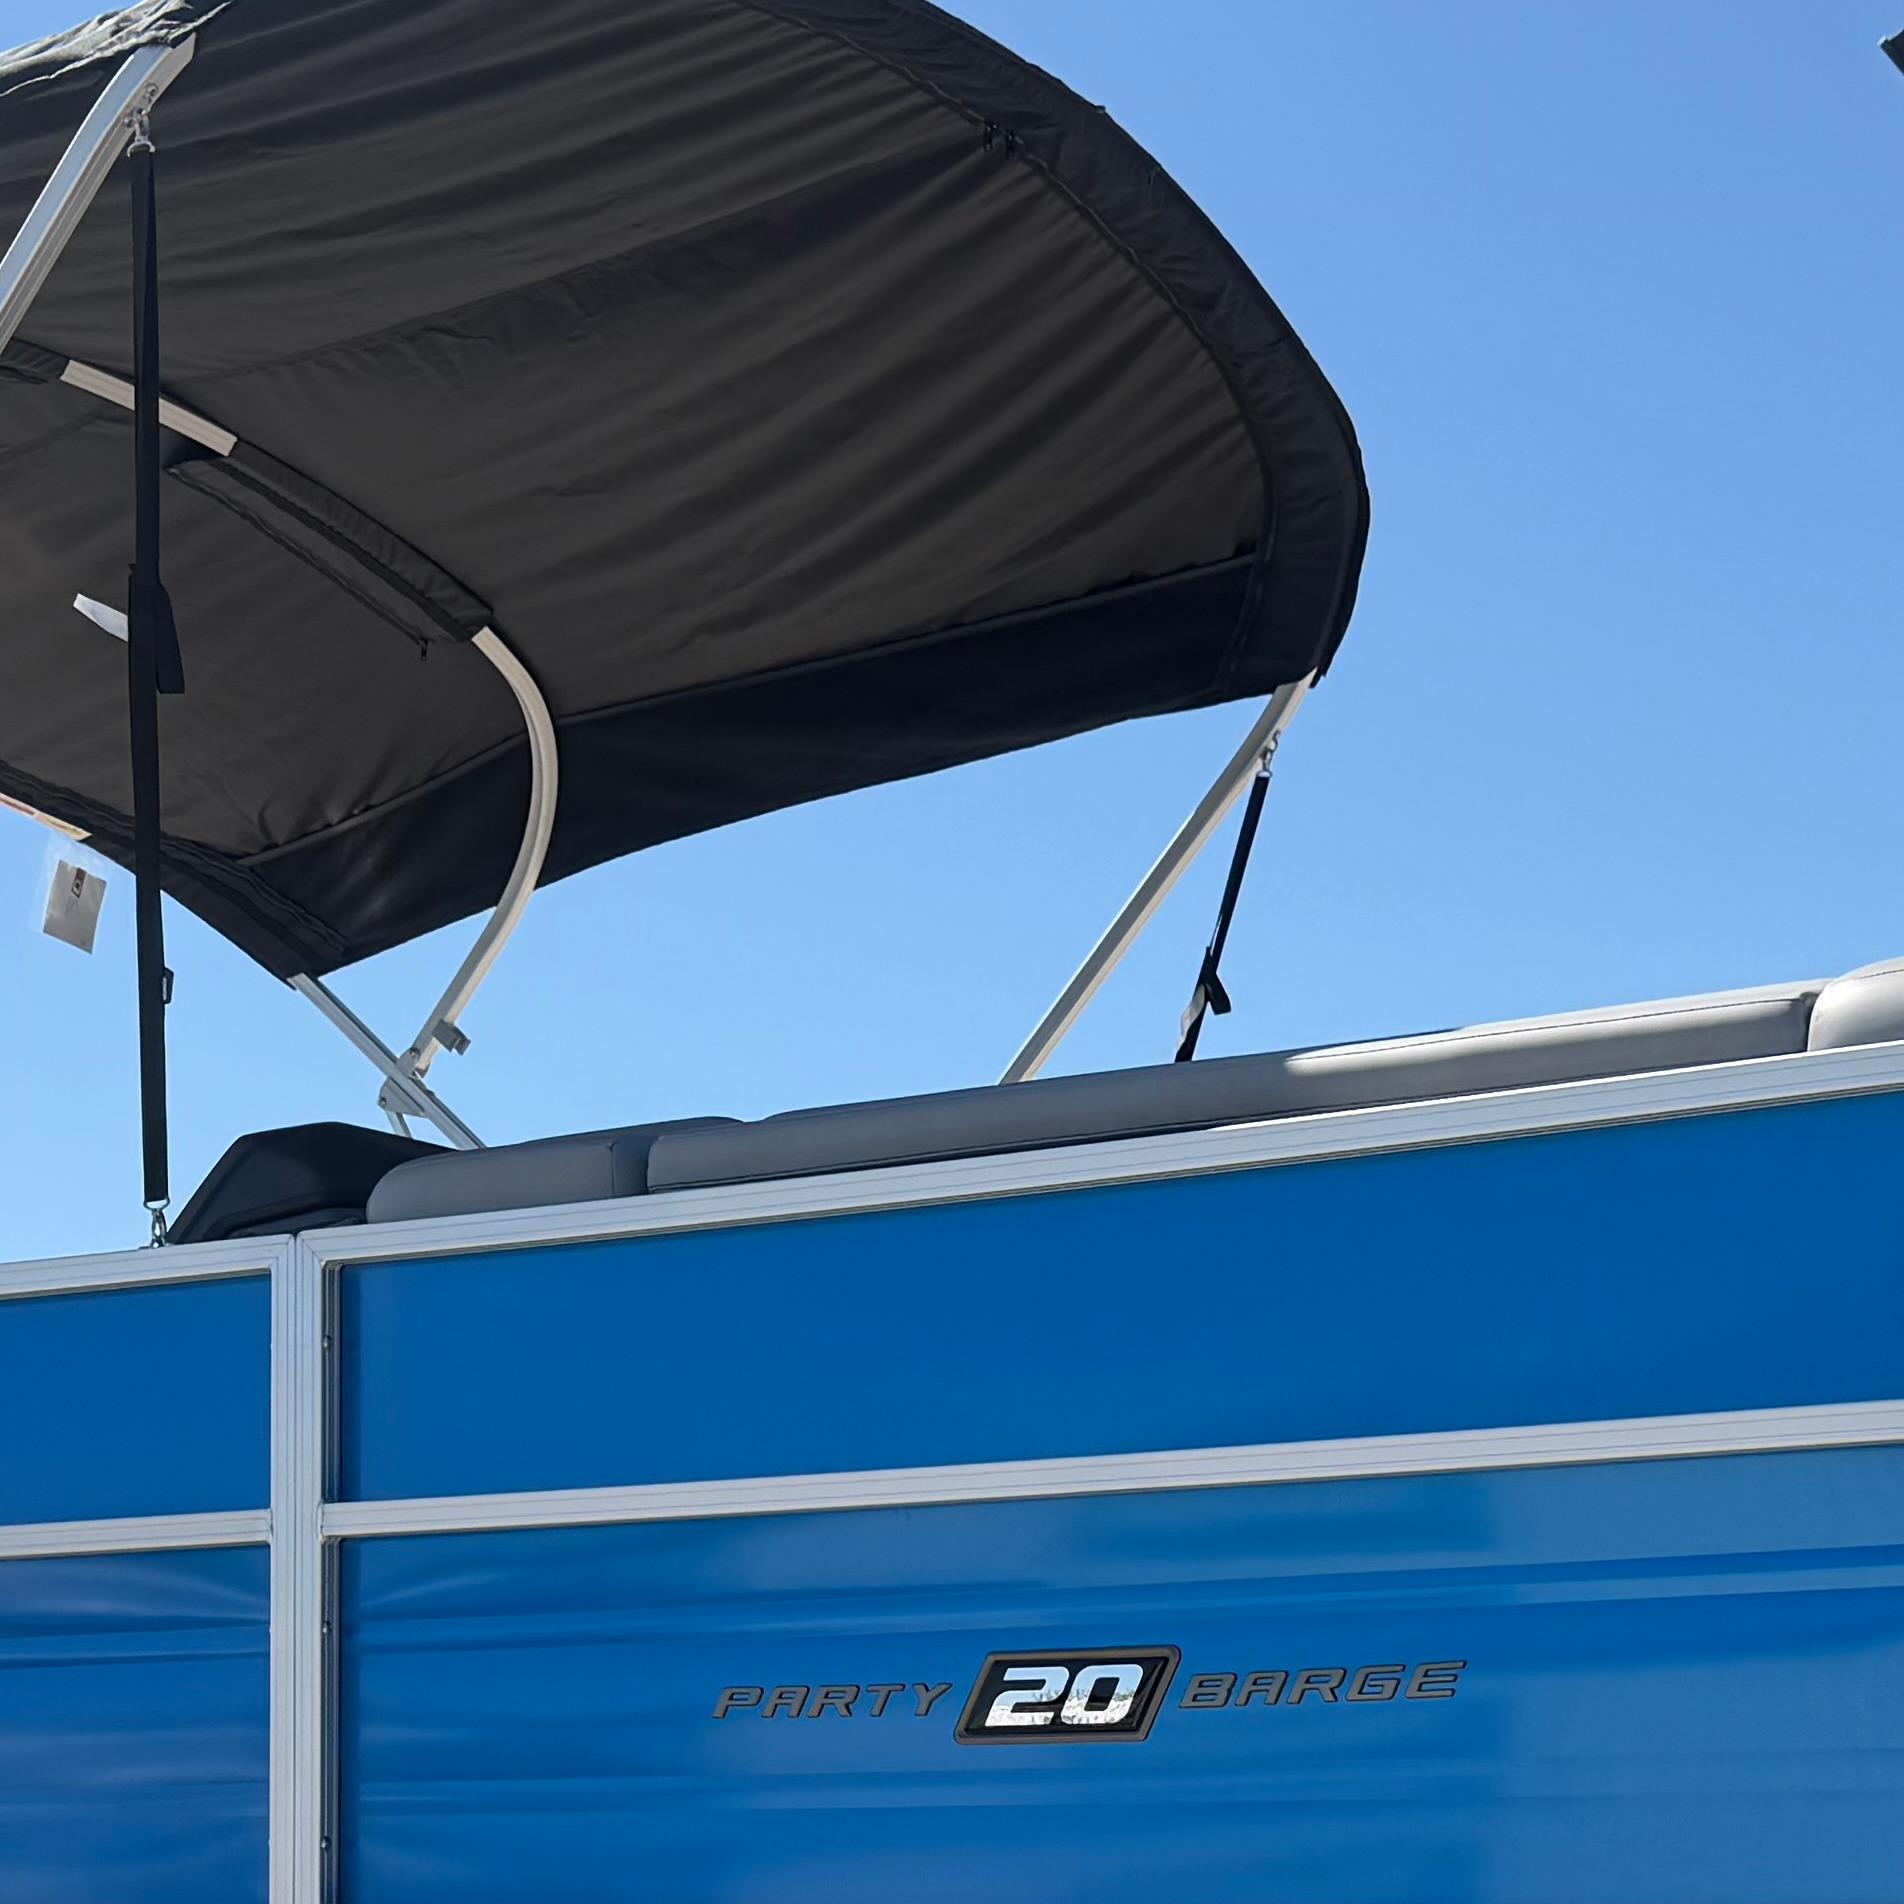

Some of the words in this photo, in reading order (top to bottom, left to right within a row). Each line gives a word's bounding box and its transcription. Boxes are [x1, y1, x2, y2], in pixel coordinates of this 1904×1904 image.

[711, 1682, 953, 1719] PARTY
[984, 1664, 1144, 1727] 20
[1178, 1659, 1467, 1709] BARGE
